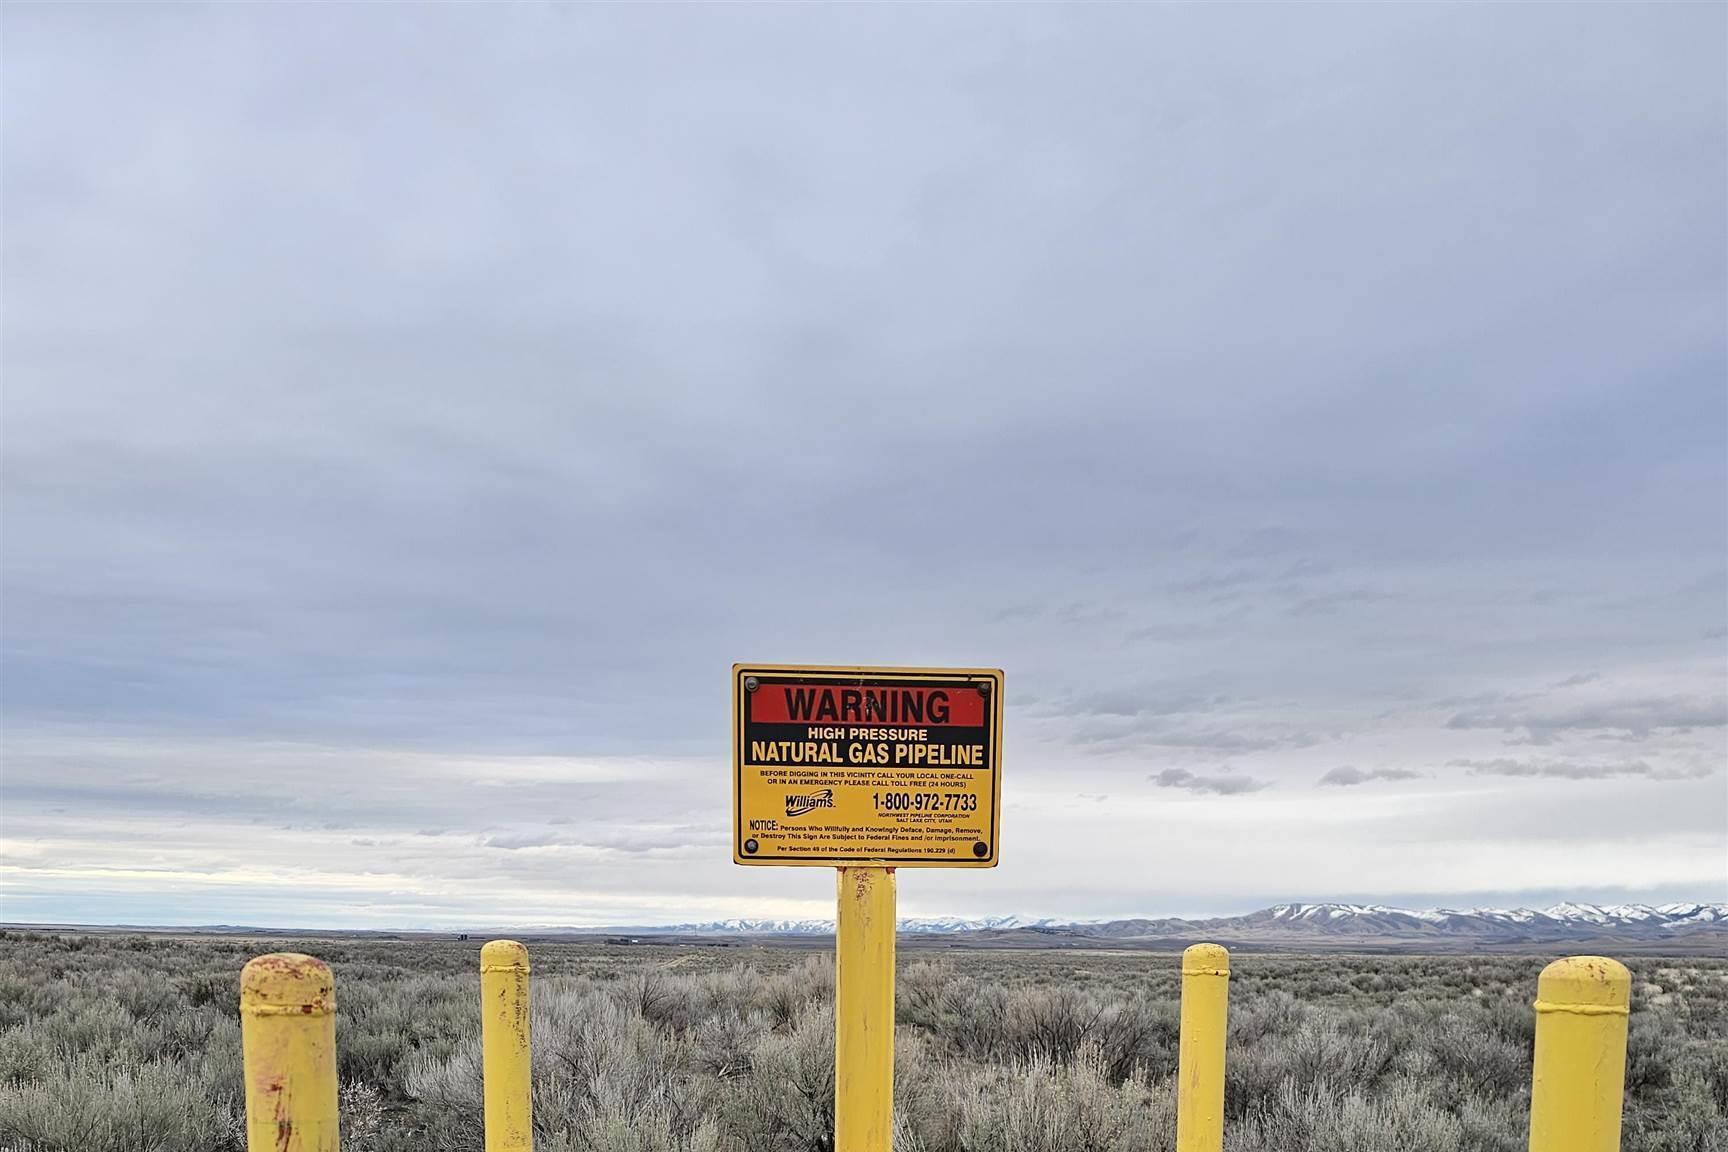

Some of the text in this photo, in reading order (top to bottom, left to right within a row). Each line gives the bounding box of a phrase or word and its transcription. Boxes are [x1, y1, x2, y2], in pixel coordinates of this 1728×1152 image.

[785, 688, 949, 723] WARNING
[808, 728, 927, 741] HIGH PRESSURE
[752, 742, 983, 765] NATURAL GAS PIPELINE
[873, 793, 977, 811] 1-800-972-7733
[750, 820, 778, 830] NOTICE:
